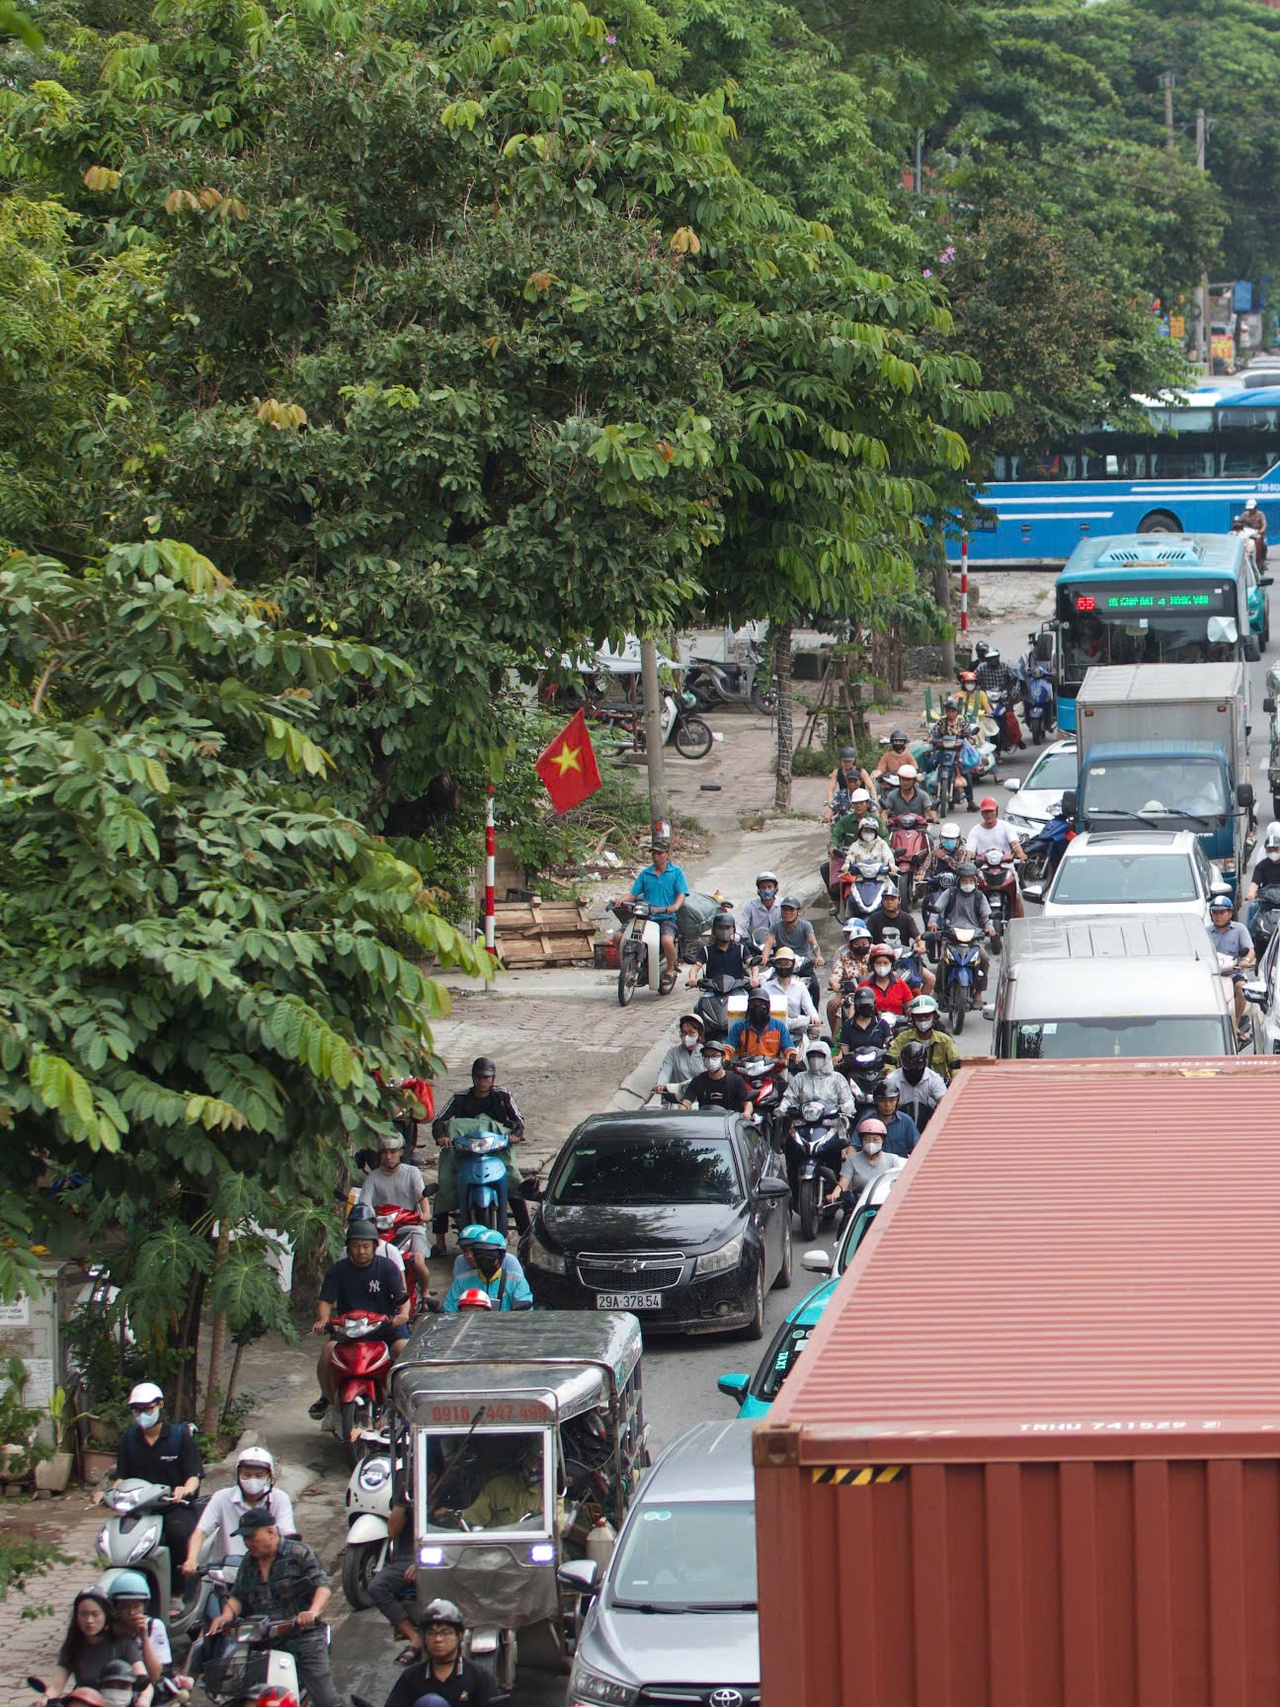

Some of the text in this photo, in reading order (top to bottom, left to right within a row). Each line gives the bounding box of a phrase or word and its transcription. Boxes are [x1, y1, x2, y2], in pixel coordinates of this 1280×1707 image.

[598, 1295, 660, 1309] 29A-378.54
[774, 1351, 789, 1370] TAXI
[486, 1404, 514, 1421] 447
[520, 1403, 548, 1420] 499
[1019, 1423, 1082, 1431] TRHU
[1091, 1421, 1186, 1430] 741529
